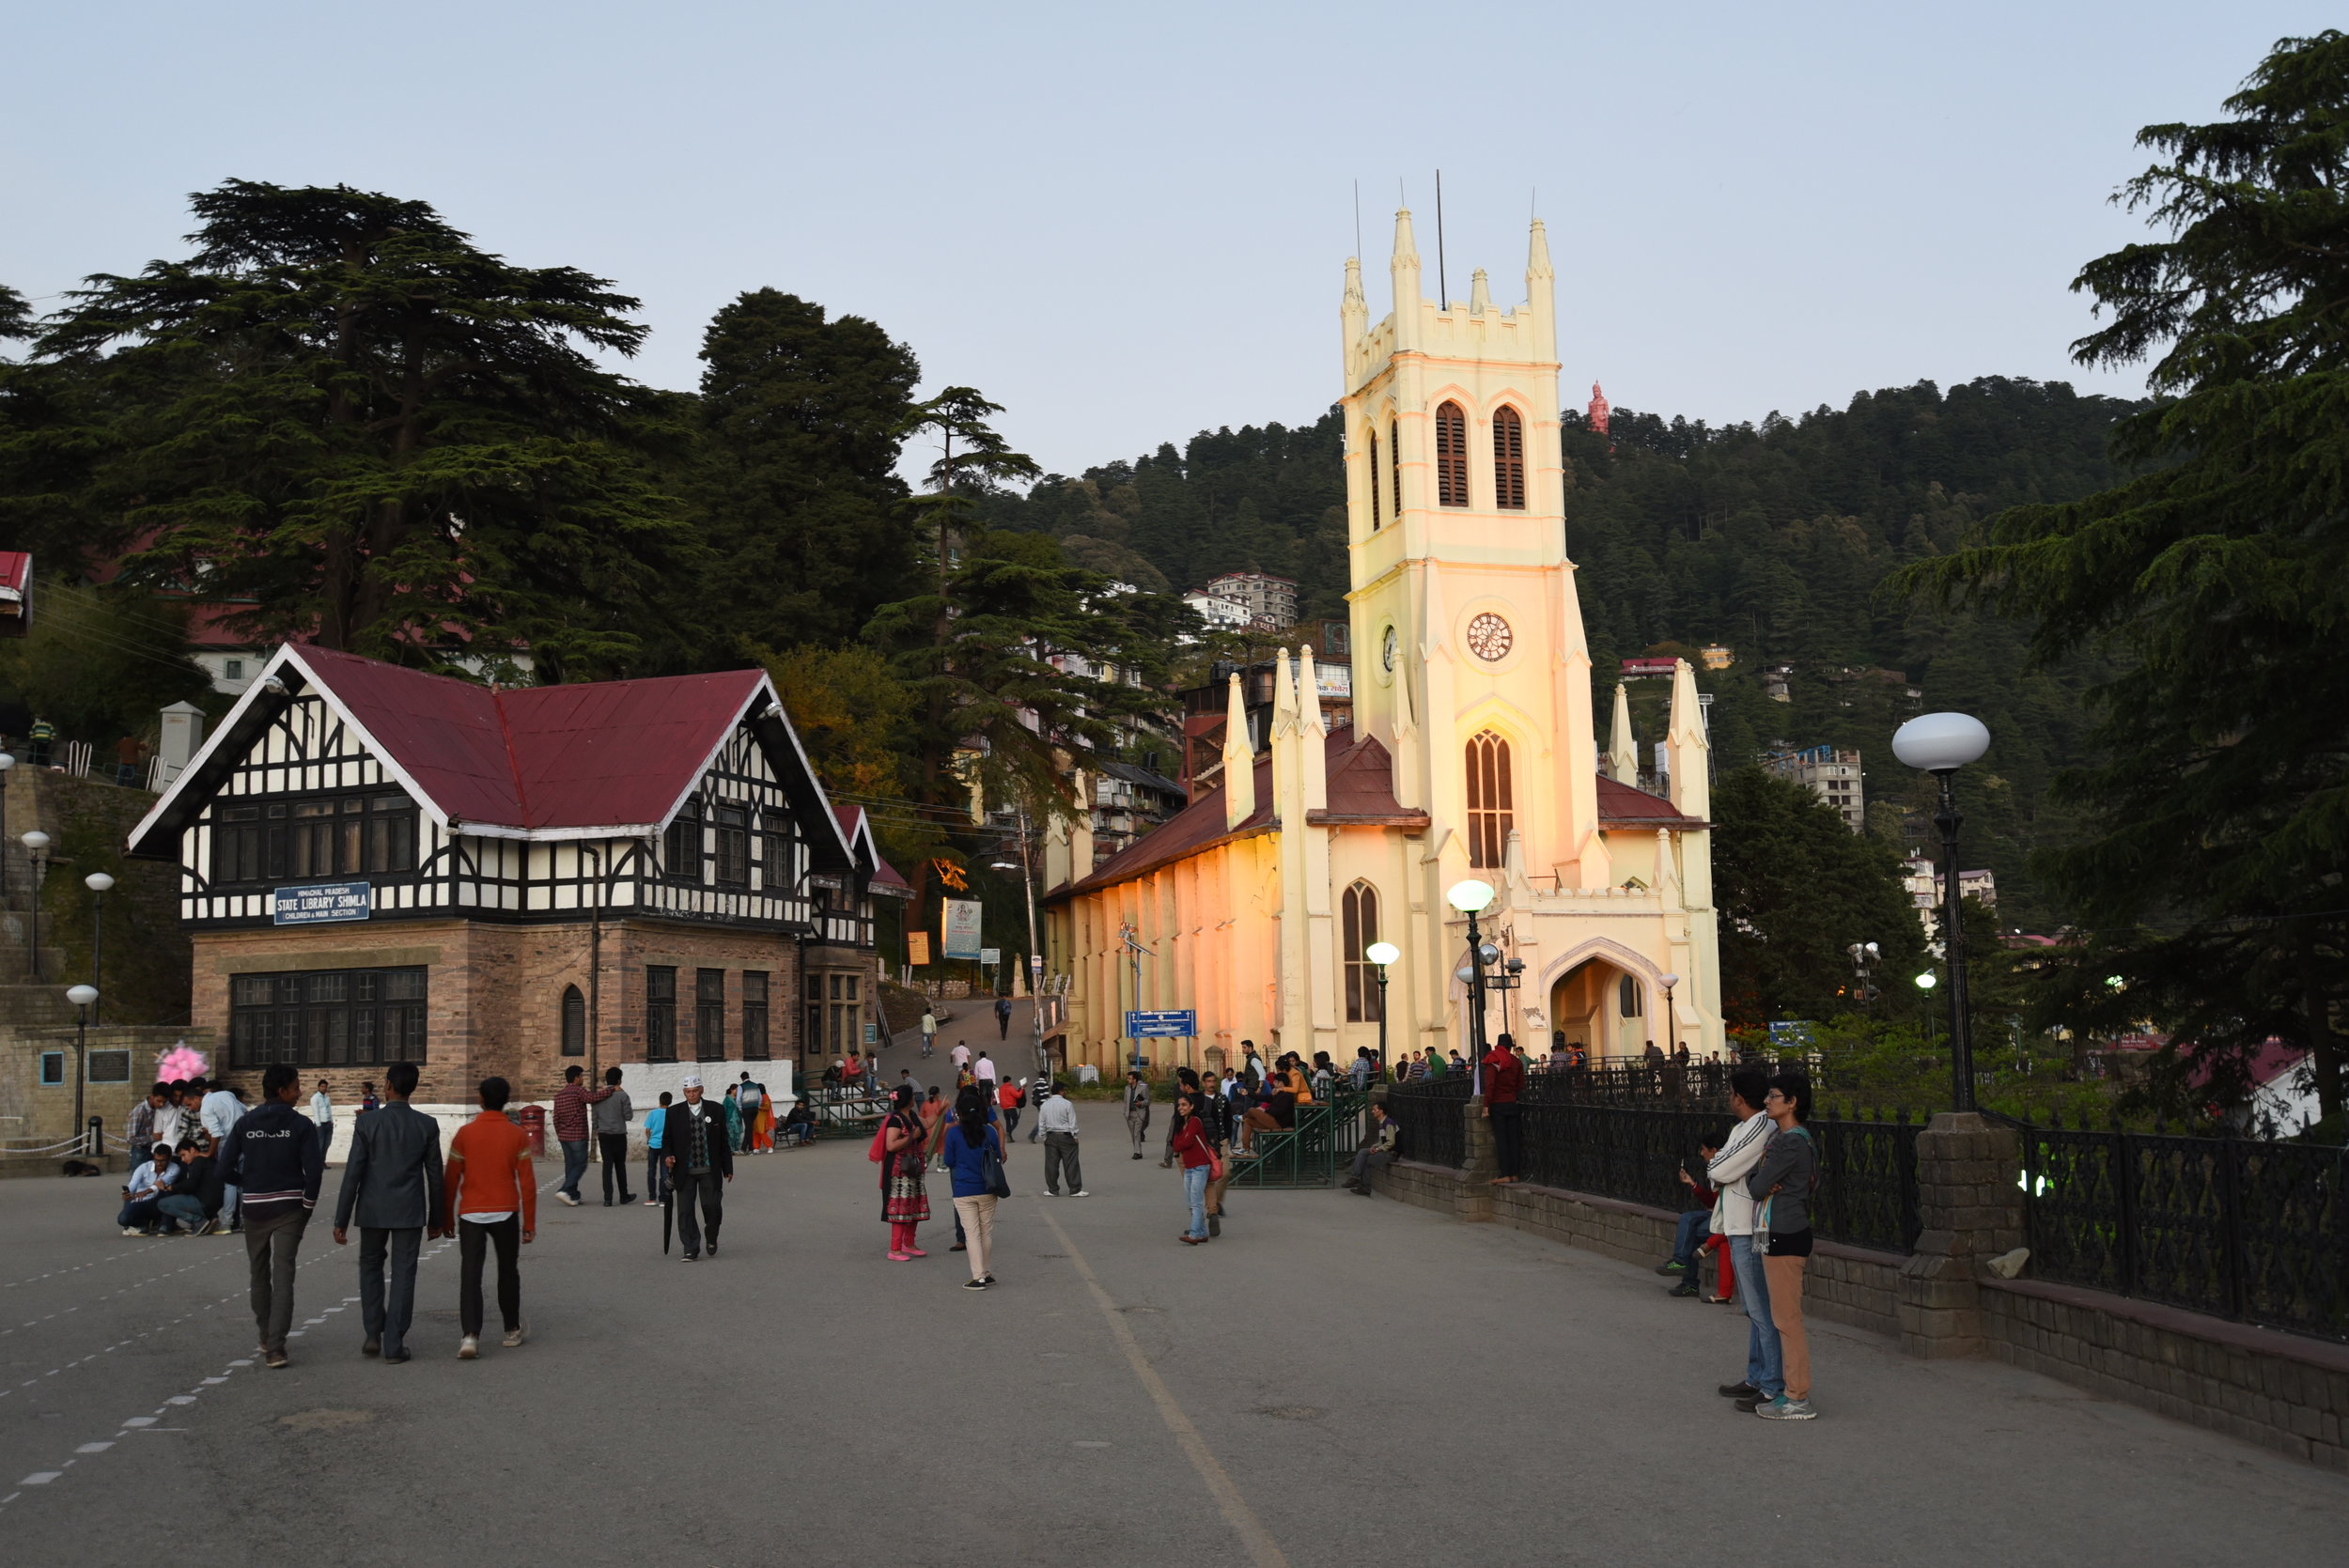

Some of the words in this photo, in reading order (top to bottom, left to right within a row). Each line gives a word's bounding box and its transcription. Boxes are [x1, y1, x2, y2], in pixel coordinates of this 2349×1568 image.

[325, 887, 350, 895] PRADESH
[277, 899, 298, 911] STATE
[302, 896, 334, 910] LIBRARY
[337, 894, 366, 908] SHIMLA
[331, 908, 360, 917] SECTION)
